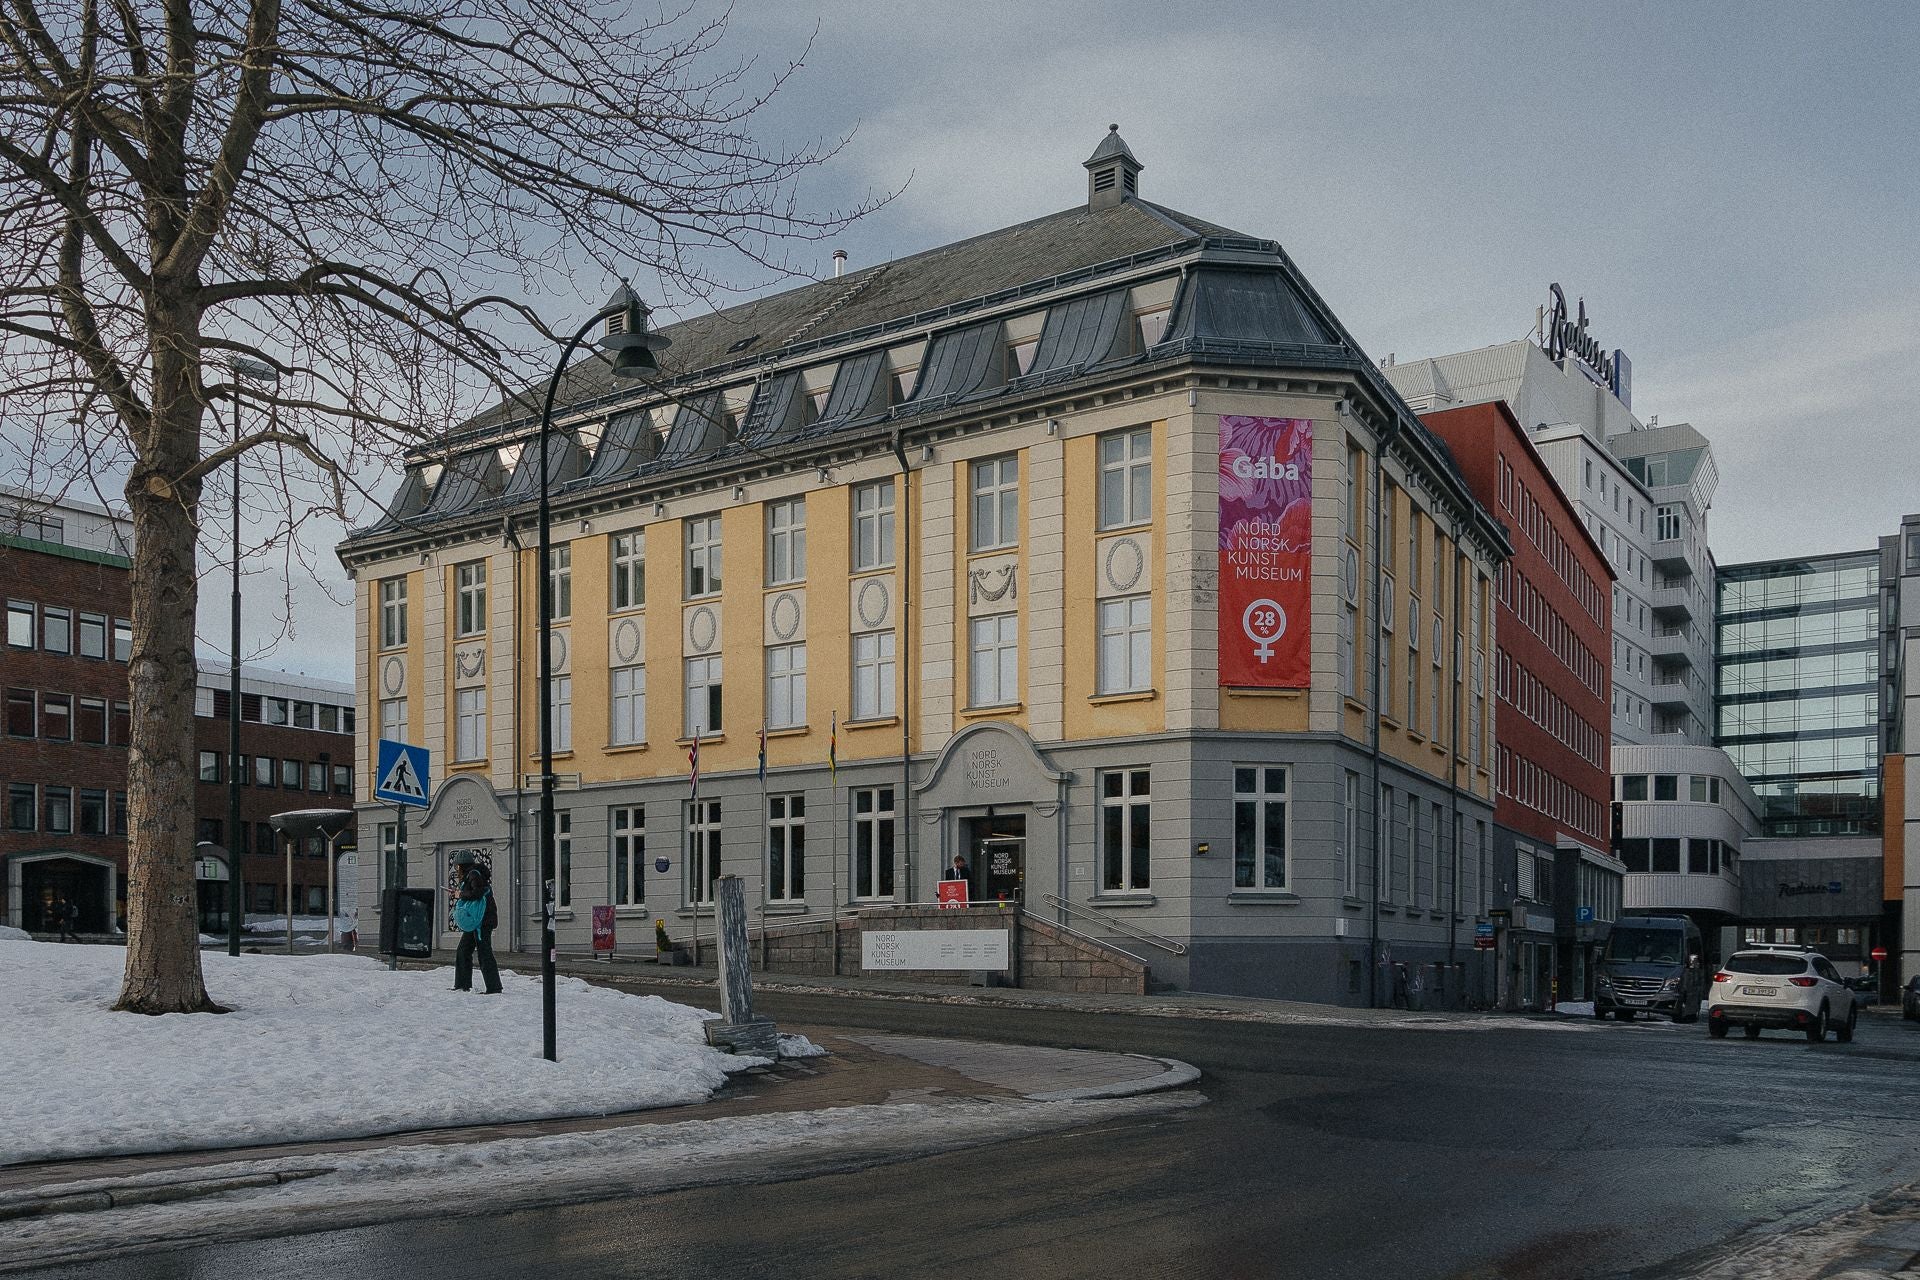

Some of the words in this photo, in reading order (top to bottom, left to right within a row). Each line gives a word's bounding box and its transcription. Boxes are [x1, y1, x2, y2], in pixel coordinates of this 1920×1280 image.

[1232, 456, 1299, 481] Gába
[1238, 522, 1281, 537] NORD
[1238, 536, 1290, 551] NORSK
[1228, 551, 1279, 566] KUNST
[1236, 566, 1302, 582] MUSEUM
[1254, 610, 1275, 627] 28
[972, 750, 997, 760] NORD
[972, 759, 1002, 770] NORSK
[966, 769, 996, 779] KUNST
[970, 778, 1010, 789] MUSEUM
[455, 819, 479, 827] MUSEUM
[1579, 908, 1589, 920] P
[875, 934, 896, 942] NORD
[875, 942, 900, 950] NORSK
[871, 950, 895, 958] KUNST
[875, 958, 906, 967] MUSEUM
